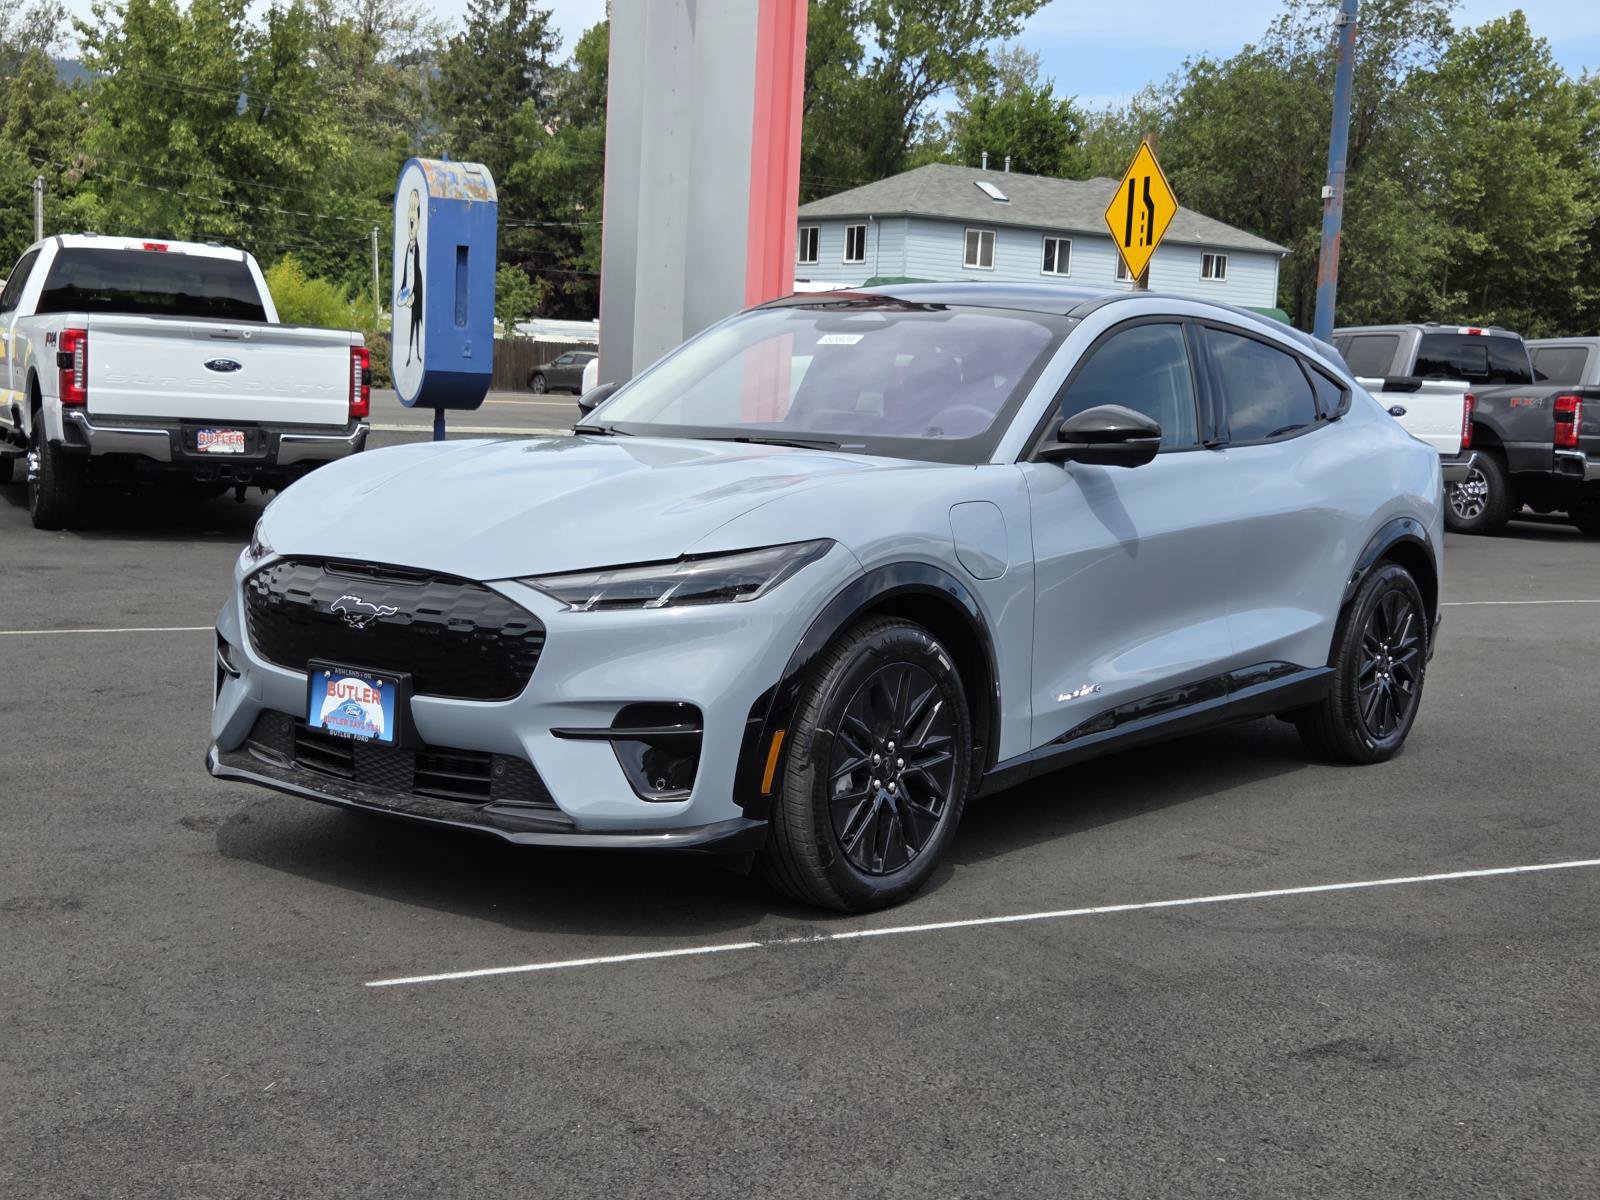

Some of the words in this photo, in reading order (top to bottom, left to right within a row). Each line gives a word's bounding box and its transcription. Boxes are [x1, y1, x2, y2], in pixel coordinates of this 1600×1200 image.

[104, 372, 233, 389] SUPER
[244, 381, 337, 394] DUTY
[1510, 398, 1544, 408] FX4
[200, 433, 244, 445] BUTLER
[327, 680, 381, 705] BUTLER
[329, 730, 351, 739] BUTLER
[353, 733, 369, 743] FORD
